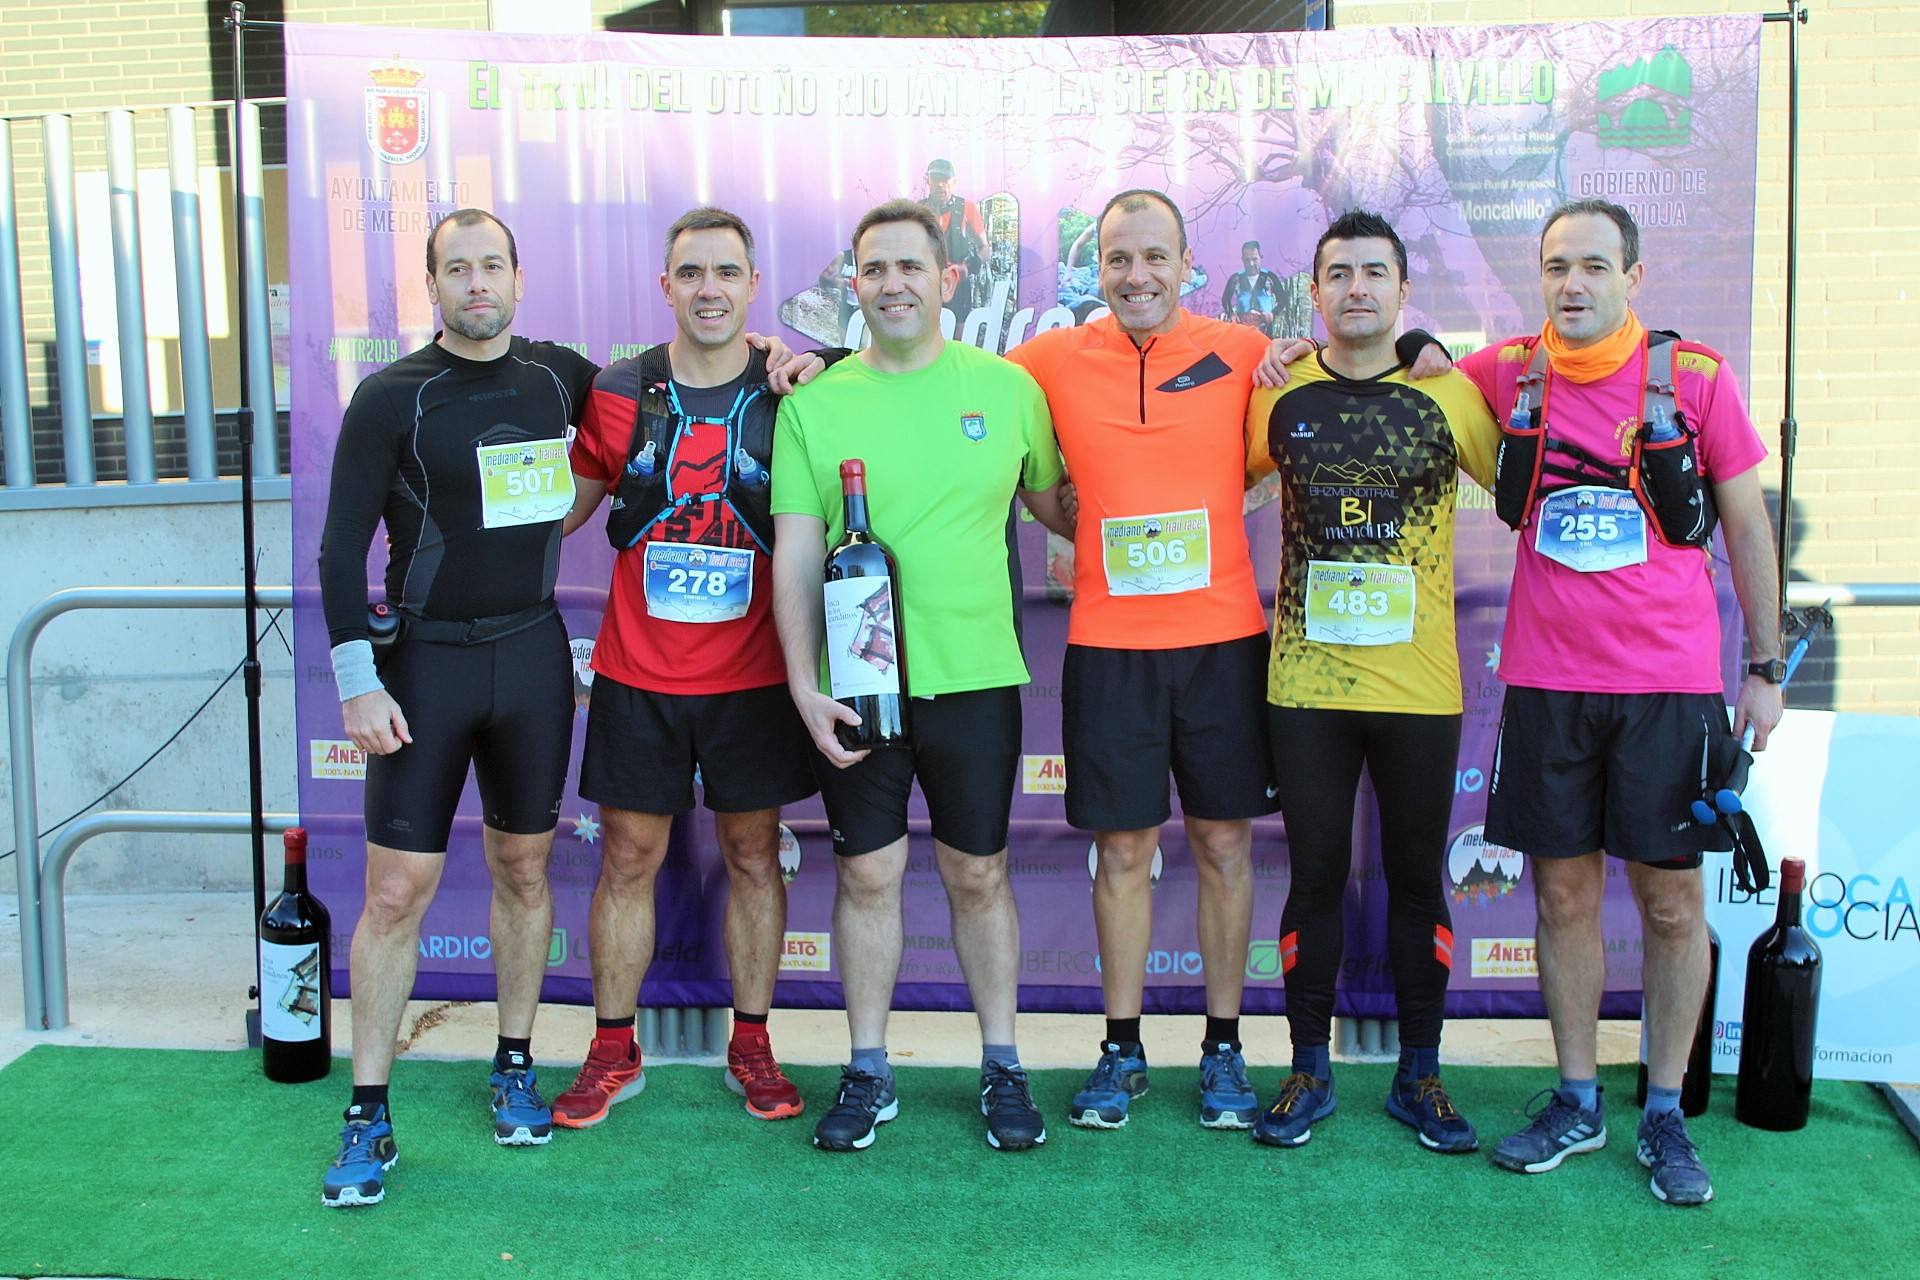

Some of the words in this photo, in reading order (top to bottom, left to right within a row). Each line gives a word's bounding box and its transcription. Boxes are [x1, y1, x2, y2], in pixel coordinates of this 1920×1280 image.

[468, 60, 501, 110] EL
[628, 66, 692, 113] DEL
[703, 64, 818, 117] OTOÑO
[1110, 63, 1239, 116] SIERRA
[1249, 66, 1296, 112] DE
[1580, 171, 1675, 197] GOBIERNO
[1681, 169, 1707, 194] DE
[343, 206, 365, 233] DE
[372, 207, 453, 234] MEDRAN
[1628, 202, 1687, 227] RIOJA
[328, 337, 398, 364] #MTR2019
[505, 466, 556, 497] 507
[1559, 513, 1620, 542] 255
[1126, 538, 1188, 569] 506
[667, 568, 728, 597] 278
[1328, 589, 1390, 617] 483
[571, 643, 592, 661] edra
[325, 743, 367, 765] ANET
